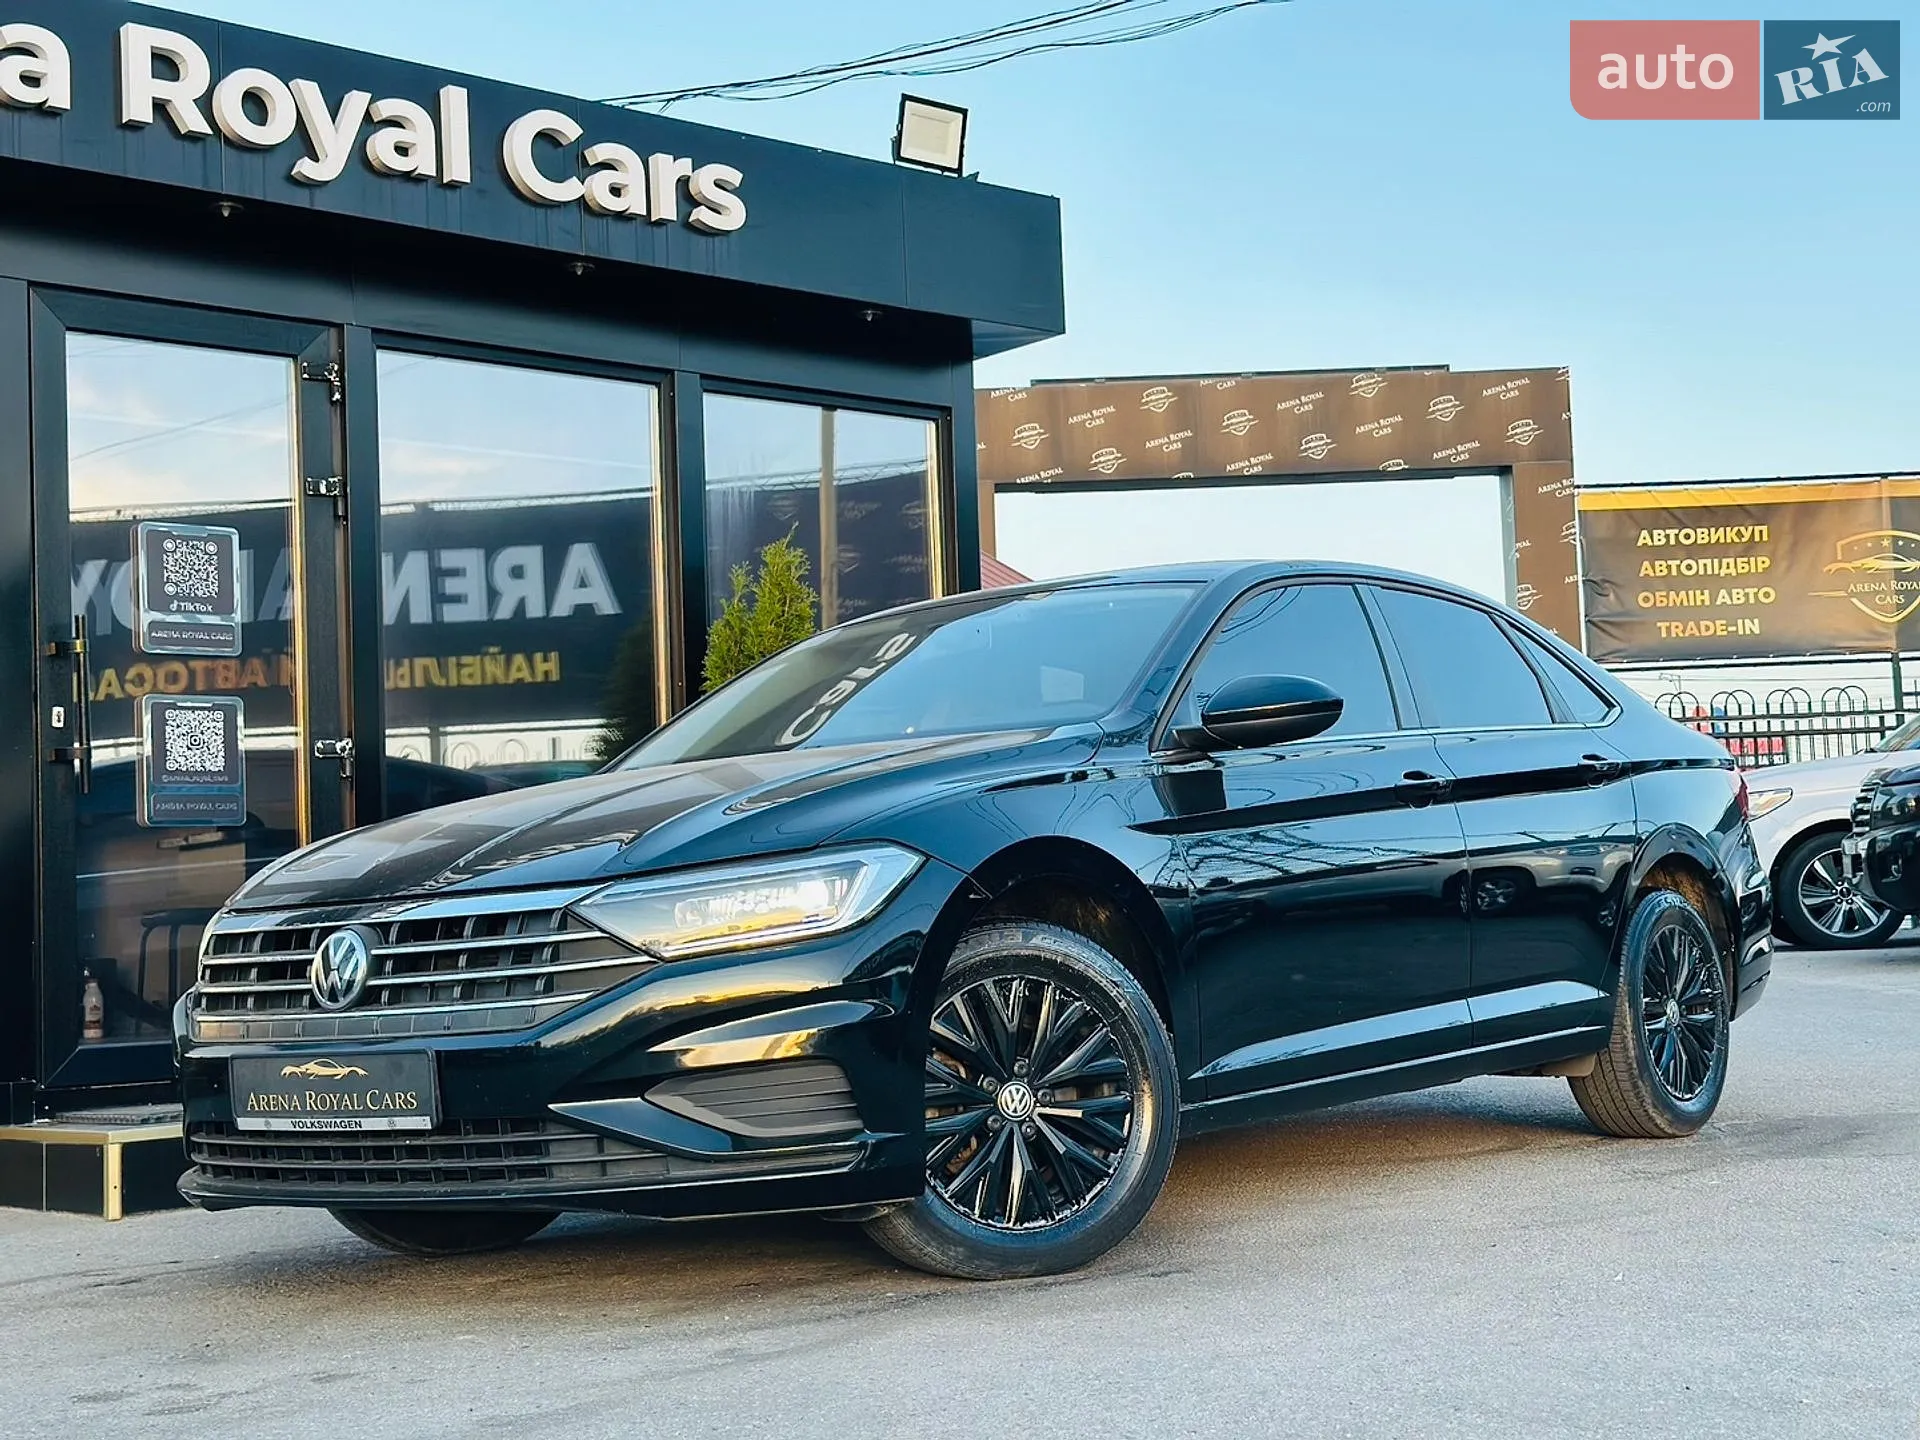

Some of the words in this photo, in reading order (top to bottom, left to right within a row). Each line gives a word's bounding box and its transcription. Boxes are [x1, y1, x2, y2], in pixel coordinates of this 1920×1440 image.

[119, 22, 471, 187] Royal
[503, 109, 747, 234] Cars
[1482, 384, 1506, 397] ARENA
[1506, 377, 1530, 389] ROYAL
[1499, 389, 1520, 400] CARS
[1276, 399, 1301, 411] ARENA
[1300, 391, 1324, 403] ROYAL
[1294, 403, 1313, 414] CARS
[1068, 412, 1092, 425] ARENA
[1092, 405, 1116, 417] ROYAL
[1085, 418, 1105, 428] CARS
[1355, 421, 1379, 434] ARENA
[1379, 414, 1403, 427] ROYAL
[1145, 437, 1169, 449] ARENA
[1169, 429, 1193, 442] ROYAL
[1373, 427, 1392, 438] CARS
[1162, 442, 1182, 453] CARS
[1433, 447, 1457, 460] ARENA
[1457, 440, 1480, 453] ROYAL
[1226, 459, 1250, 472] ARENA
[1250, 452, 1274, 465] ROYAL
[1450, 453, 1470, 463] CARS
[1243, 465, 1262, 475] CARS
[1636, 525, 1769, 547] АВТОВИКУП
[1638, 556, 1771, 578] АВТОПІДБІР
[1848, 583, 1887, 593] ARENA
[1891, 580, 1920, 591] ROYA
[1637, 589, 1710, 608] ОБМІН
[1715, 587, 1776, 605] АВТО
[1875, 594, 1905, 604] CARS
[1656, 618, 1760, 638] TRADE-IN
[247, 1092, 301, 1111] ARENA
[306, 1090, 363, 1111] ROYAL
[366, 1089, 418, 1110] CARS
[290, 1120, 362, 1129] VOLKSWAGEN
